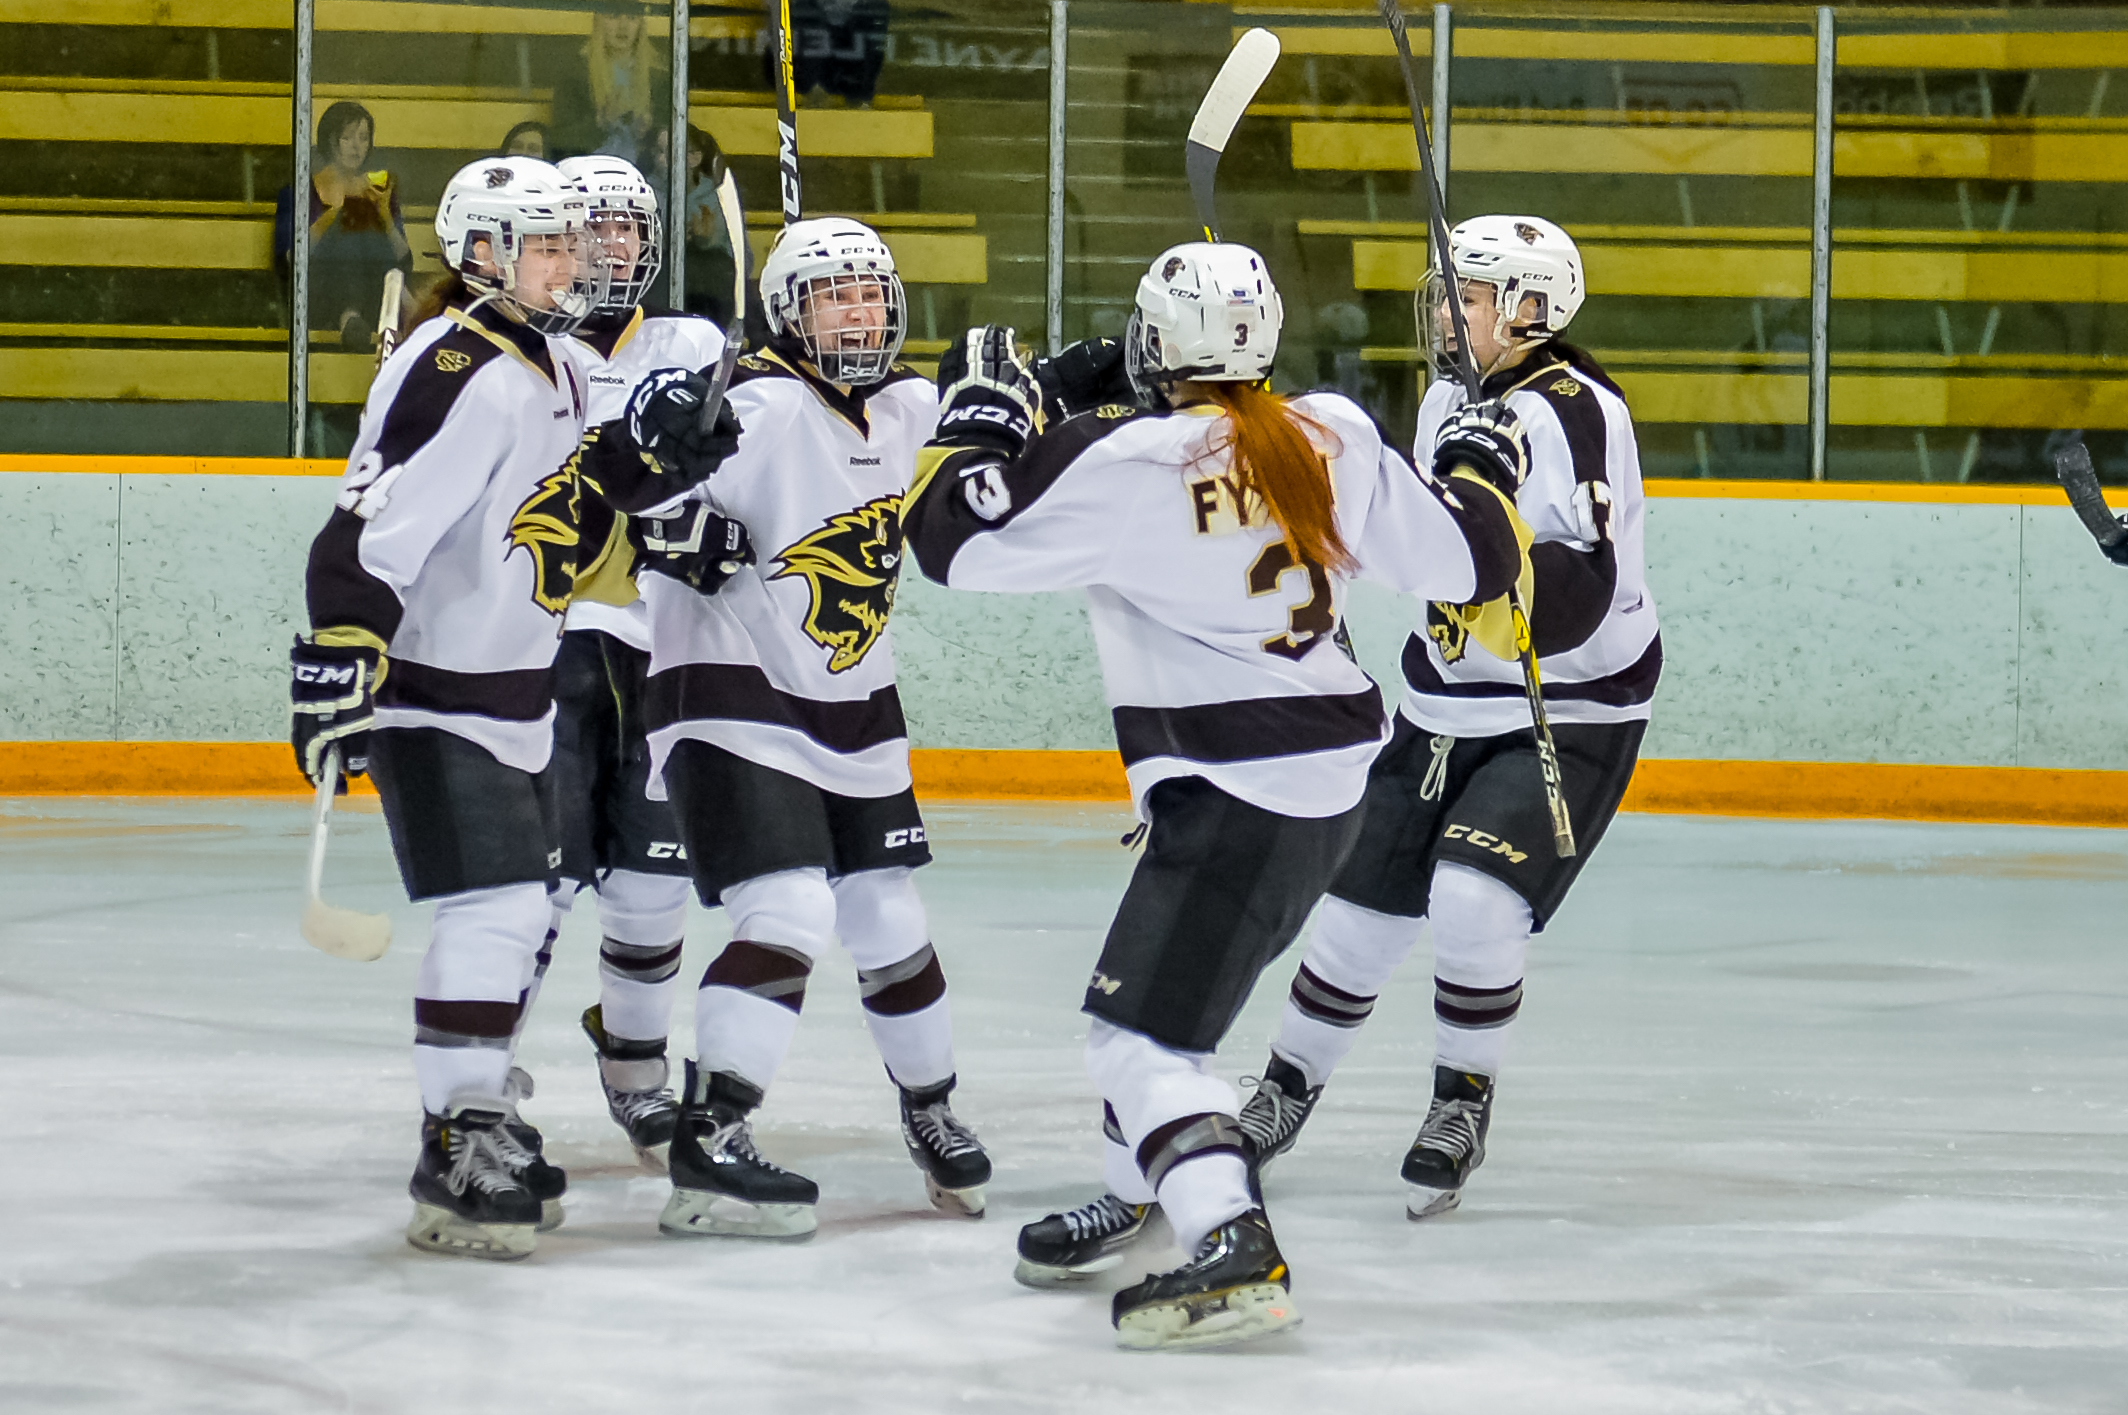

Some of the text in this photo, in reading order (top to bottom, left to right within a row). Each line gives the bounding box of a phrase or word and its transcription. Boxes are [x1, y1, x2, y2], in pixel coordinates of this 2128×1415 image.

[778, 119, 799, 218] CM
[466, 213, 499, 223] CCM
[1522, 272, 1553, 282] CCM
[1169, 288, 1200, 300] CCM
[1234, 322, 1248, 346] 3
[1246, 540, 1336, 662] 3
[296, 665, 354, 684] CM
[885, 827, 924, 848] CC
[1444, 824, 1528, 864] CCM
